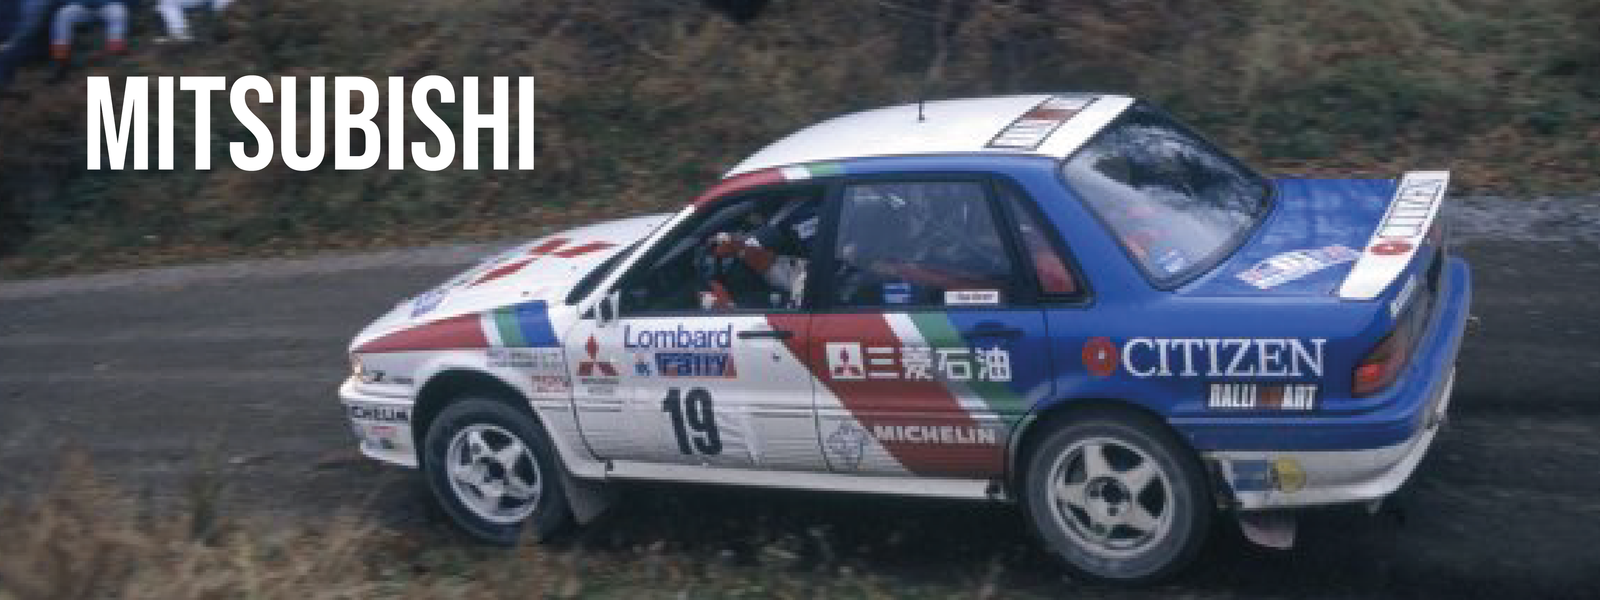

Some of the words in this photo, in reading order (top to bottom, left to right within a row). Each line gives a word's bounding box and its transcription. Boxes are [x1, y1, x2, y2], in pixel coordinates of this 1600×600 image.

[623, 324, 733, 349] Lombard
[866, 346, 1012, 382] 三菱石油
[1123, 338, 1326, 377] CITIZEN
[662, 388, 722, 455] 19
[873, 425, 996, 445] MICHELIN
